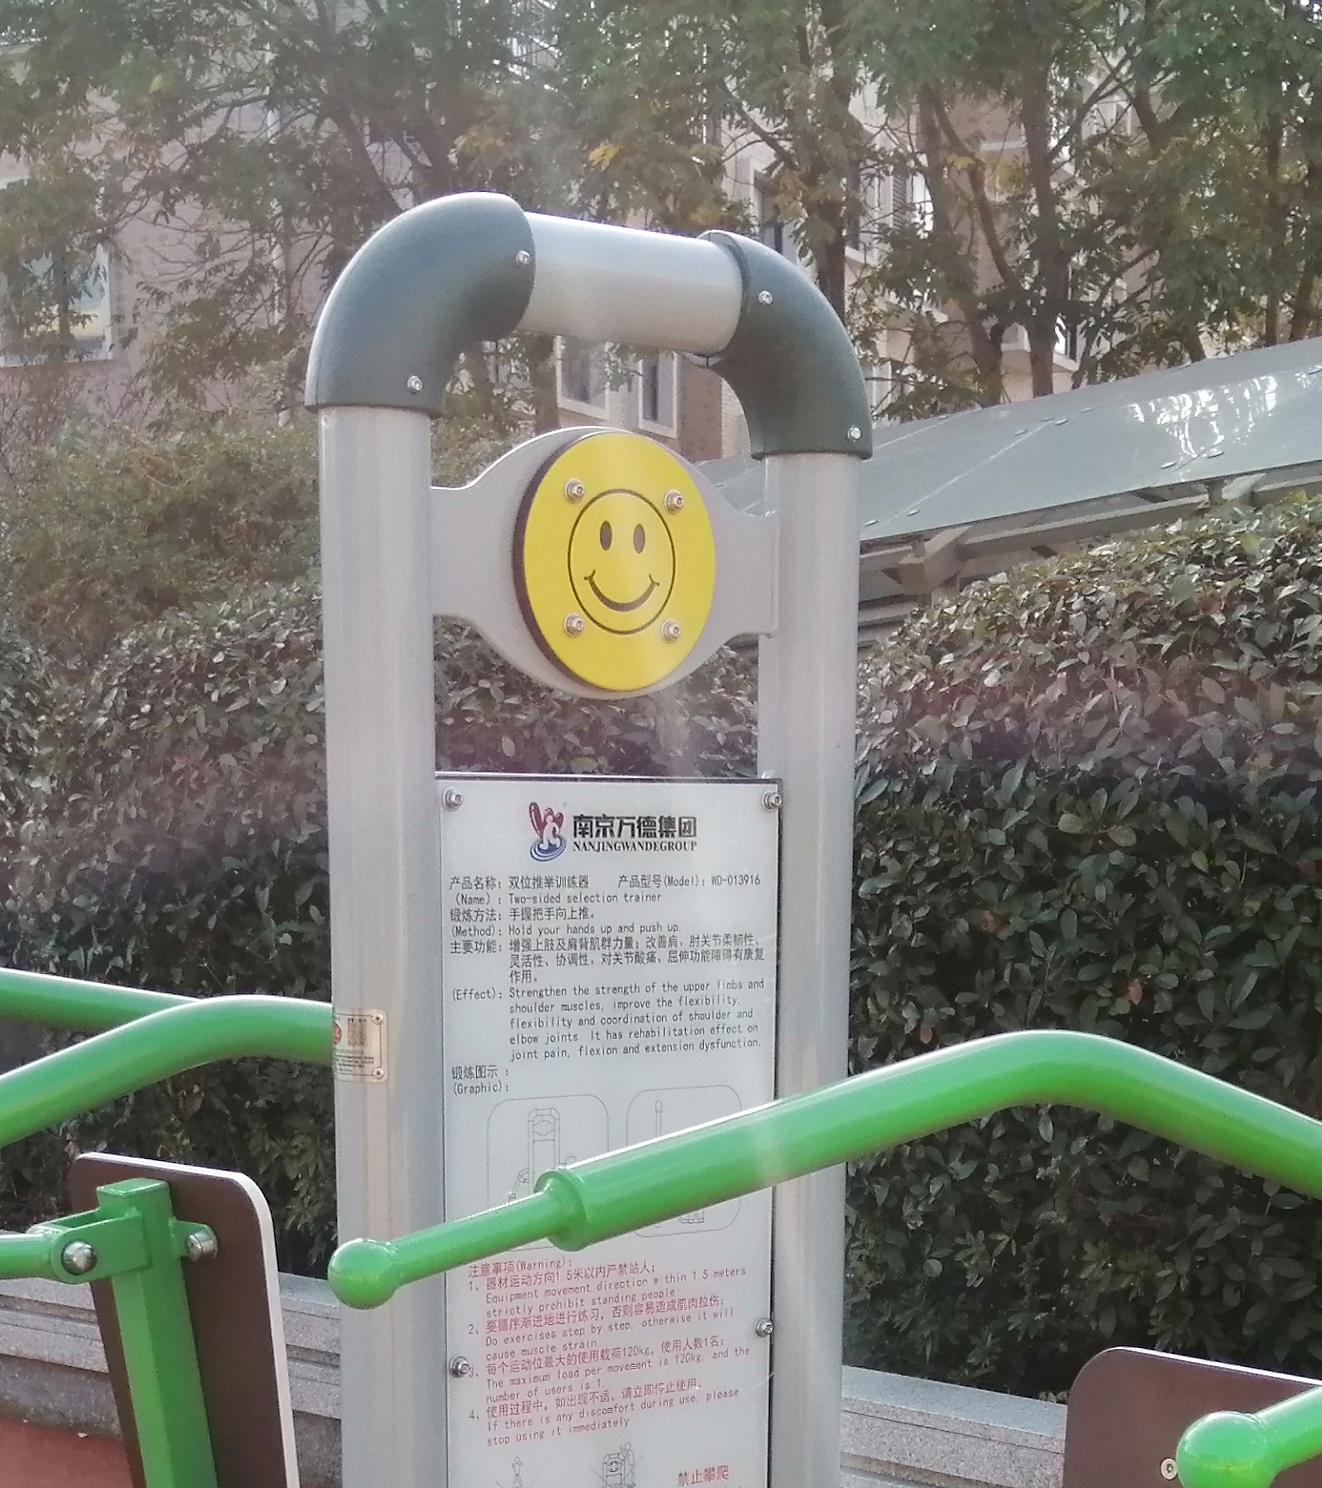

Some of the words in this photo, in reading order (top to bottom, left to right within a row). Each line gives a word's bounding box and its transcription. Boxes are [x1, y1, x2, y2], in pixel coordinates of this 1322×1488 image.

[573, 814, 697, 839] 南京万德集团
[573, 841, 697, 852] NANJINGWANDEGROUP
[449, 876, 502, 890] 产品名称：
[509, 875, 589, 890] 双位推举训练器
[711, 875, 761, 886] WD-013916
[509, 893, 561, 904] Two-sided
[567, 892, 619, 904] selection
[623, 891, 662, 902] trainer
[449, 908, 502, 922] 锻炼方法：
[509, 906, 595, 921] 手握把手向上推。
[509, 925, 533, 936] Hold
[538, 926, 560, 936] your
[567, 923, 595, 934] hands
[601, 924, 613, 934] up
[617, 922, 635, 933] and
[639, 922, 662, 934] push
[451, 940, 502, 954] 主要功能：
[509, 970, 537, 984] 作用。
[509, 986, 567, 999] Strengthen
[573, 985, 590, 996] the
[595, 982, 640, 996] strength
[645, 982, 656, 993] of
[661, 982, 677, 992] the
[683, 982, 709, 993] upper
[717, 980, 743, 990] limbs
[748, 978, 765, 989] and
[509, 1002, 555, 1014] shoulder
[613, 999, 651, 1011] improve
[657, 998, 673, 1008] the
[510, 1017, 573, 1030] flexibility
[578, 1016, 595, 1026] and
[600, 1013, 667, 1025] coordination
[673, 1012, 683, 1022] of
[689, 1010, 731, 1021] shoulder
[737, 1008, 753, 1018] and
[509, 1034, 539, 1044] elbow
[591, 1030, 601, 1041] It
[606, 1029, 623, 1040] has
[629, 1026, 705, 1039] rehabilitation
[710, 1024, 741, 1035] effect
[747, 1024, 759, 1034] on
[510, 1049, 539, 1062] joint
[579, 1045, 617, 1057] flexion
[623, 1044, 639, 1054] and
[645, 1042, 695, 1053] extension
[486, 1290, 539, 1304] Equipment
[544, 1284, 591, 1296] movement
[597, 1278, 647, 1292] direction
[653, 1273, 687, 1284] within
[713, 1268, 746, 1278] meters
[486, 1306, 533, 1318] strictly
[539, 1299, 585, 1313] prohibit
[591, 1293, 637, 1306] standing
[486, 1336, 497, 1346] Do
[504, 1330, 557, 1344] exercises
[563, 1326, 585, 1338] step
[591, 1322, 602, 1334] by
[641, 1314, 691, 1328] otherwise
[698, 1311, 707, 1320] it
[713, 1307, 734, 1318] will
[486, 1350, 515, 1361] cause
[521, 1344, 557, 1357] muscle
[487, 1379, 503, 1389] The
[509, 1374, 551, 1386] maximum
[557, 1368, 579, 1380] load
[585, 1366, 602, 1378] per
[607, 1360, 653, 1373] movement
[659, 1356, 669, 1366] is
[712, 1348, 729, 1360] and
[735, 1346, 750, 1357] the
[487, 1392, 519, 1404] number
[527, 1387, 539, 1398] of
[545, 1385, 573, 1396] users
[580, 1381, 591, 1391] is
[487, 1421, 498, 1432] If
[505, 1418, 533, 1429] there
[540, 1414, 551, 1424] is
[557, 1412, 574, 1423] any
[579, 1403, 635, 1419] discomfort
[640, 1398, 674, 1410] during
[706, 1388, 739, 1402] please
[487, 1436, 511, 1447] stop
[516, 1430, 545, 1442] using
[551, 1426, 561, 1436] it
[677, 1465, 729, 1487] 禁止攀爬
